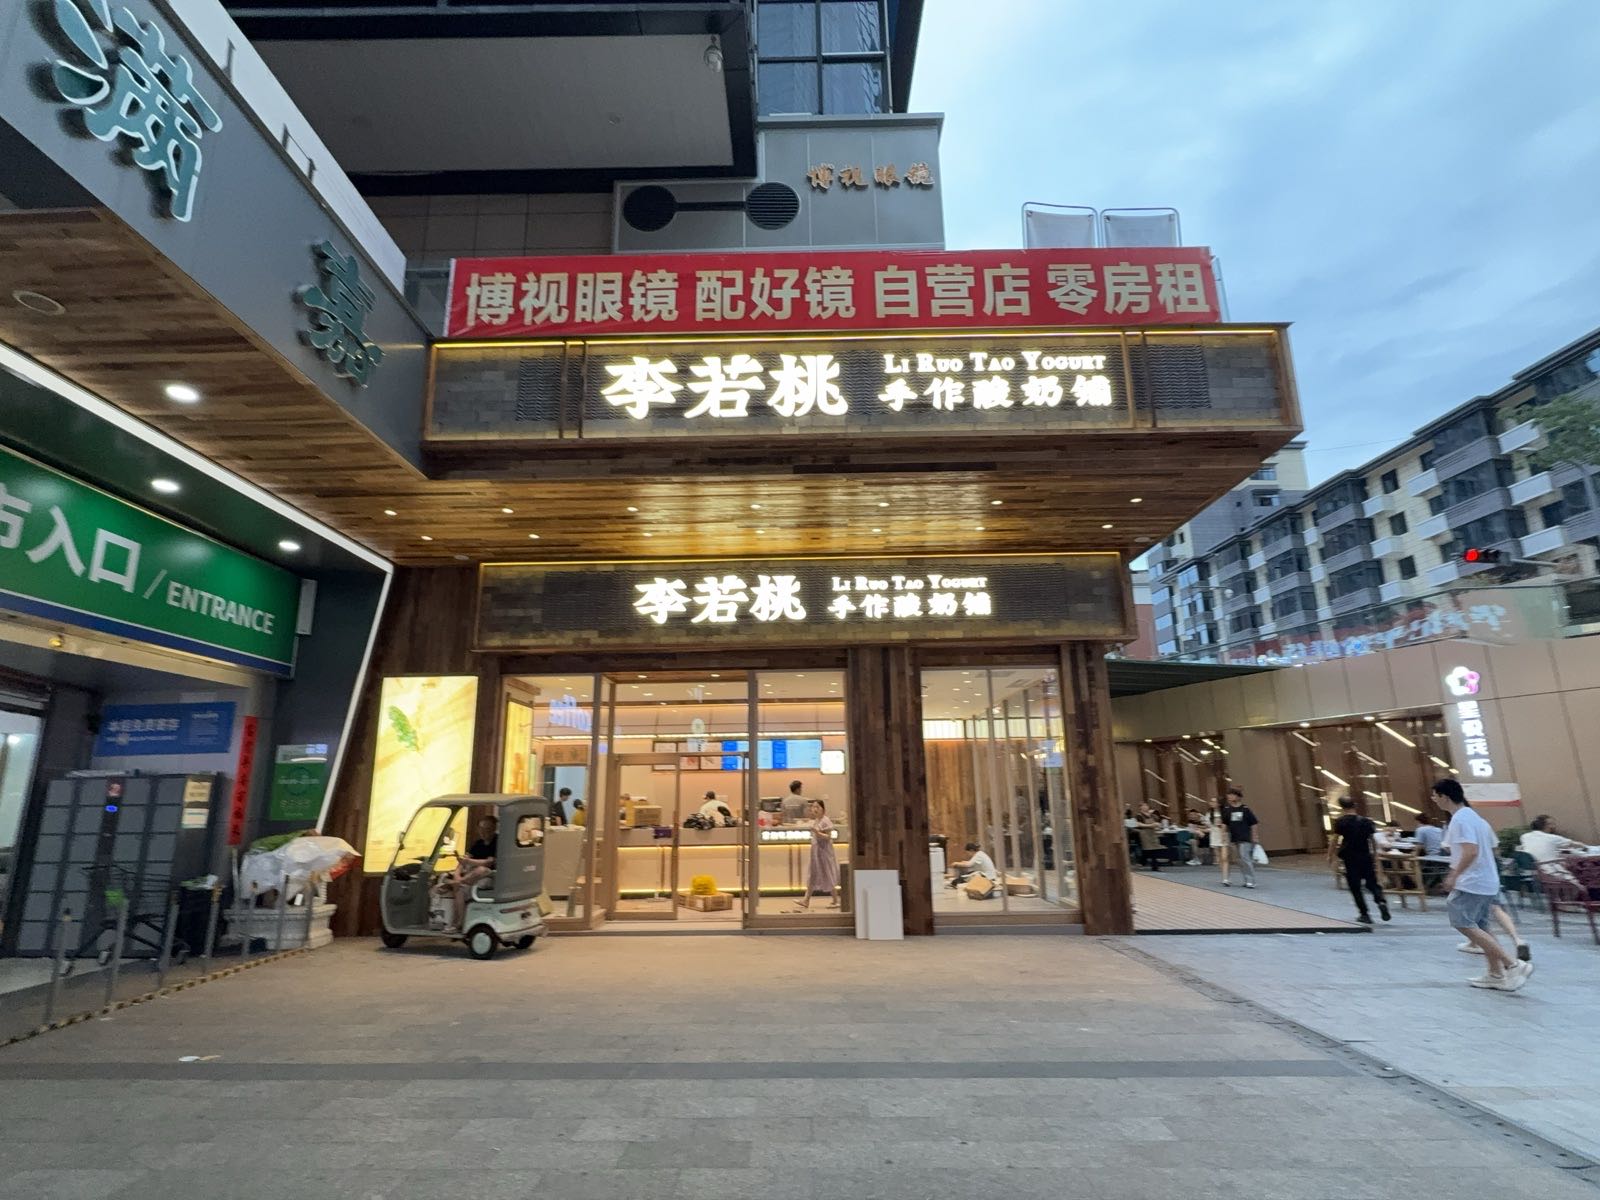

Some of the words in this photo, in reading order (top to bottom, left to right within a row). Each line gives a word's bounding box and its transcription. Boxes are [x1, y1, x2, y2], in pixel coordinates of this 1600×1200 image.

[465, 269, 679, 327] 博视眼镜
[695, 266, 856, 321] 配好镜
[873, 263, 1031, 318] 自营店
[1046, 262, 1210, 316] 零房租
[601, 353, 849, 420] 李若桃
[877, 374, 1113, 412] 手作酸奶铺
[166, 580, 275, 635] ENTRANCE
[632, 574, 807, 624] 李若桃
